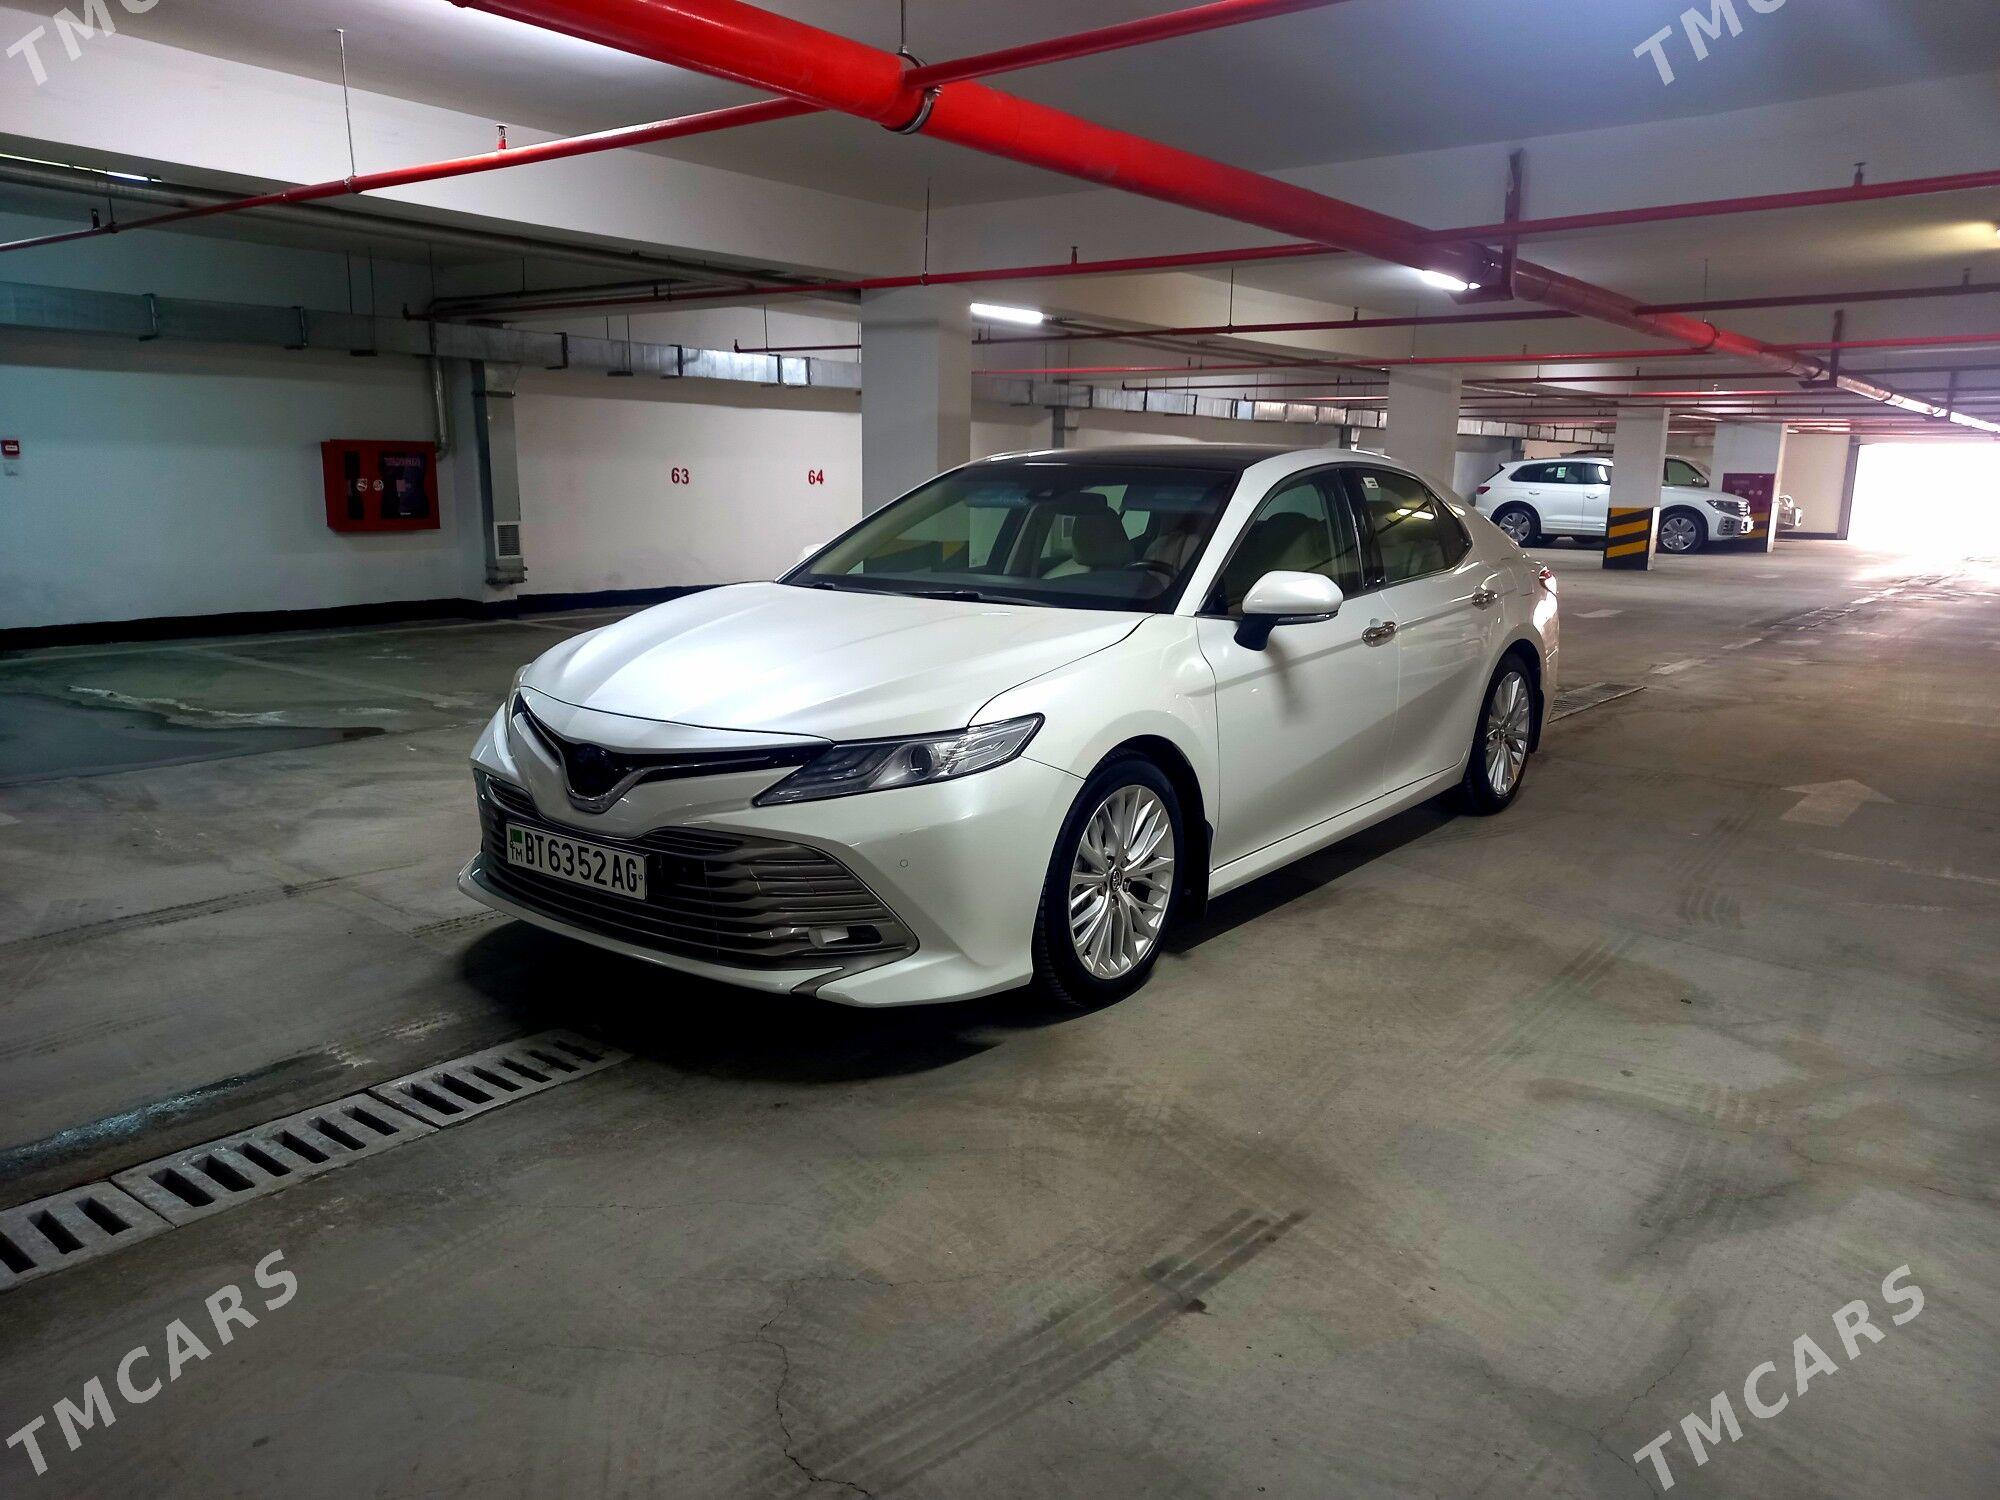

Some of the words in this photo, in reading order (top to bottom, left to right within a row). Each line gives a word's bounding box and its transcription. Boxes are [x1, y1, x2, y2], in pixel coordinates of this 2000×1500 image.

[671, 467, 690, 485] 63
[808, 469, 825, 485] 64
[511, 846, 523, 862] TM
[525, 831, 637, 893] BT6352AG
